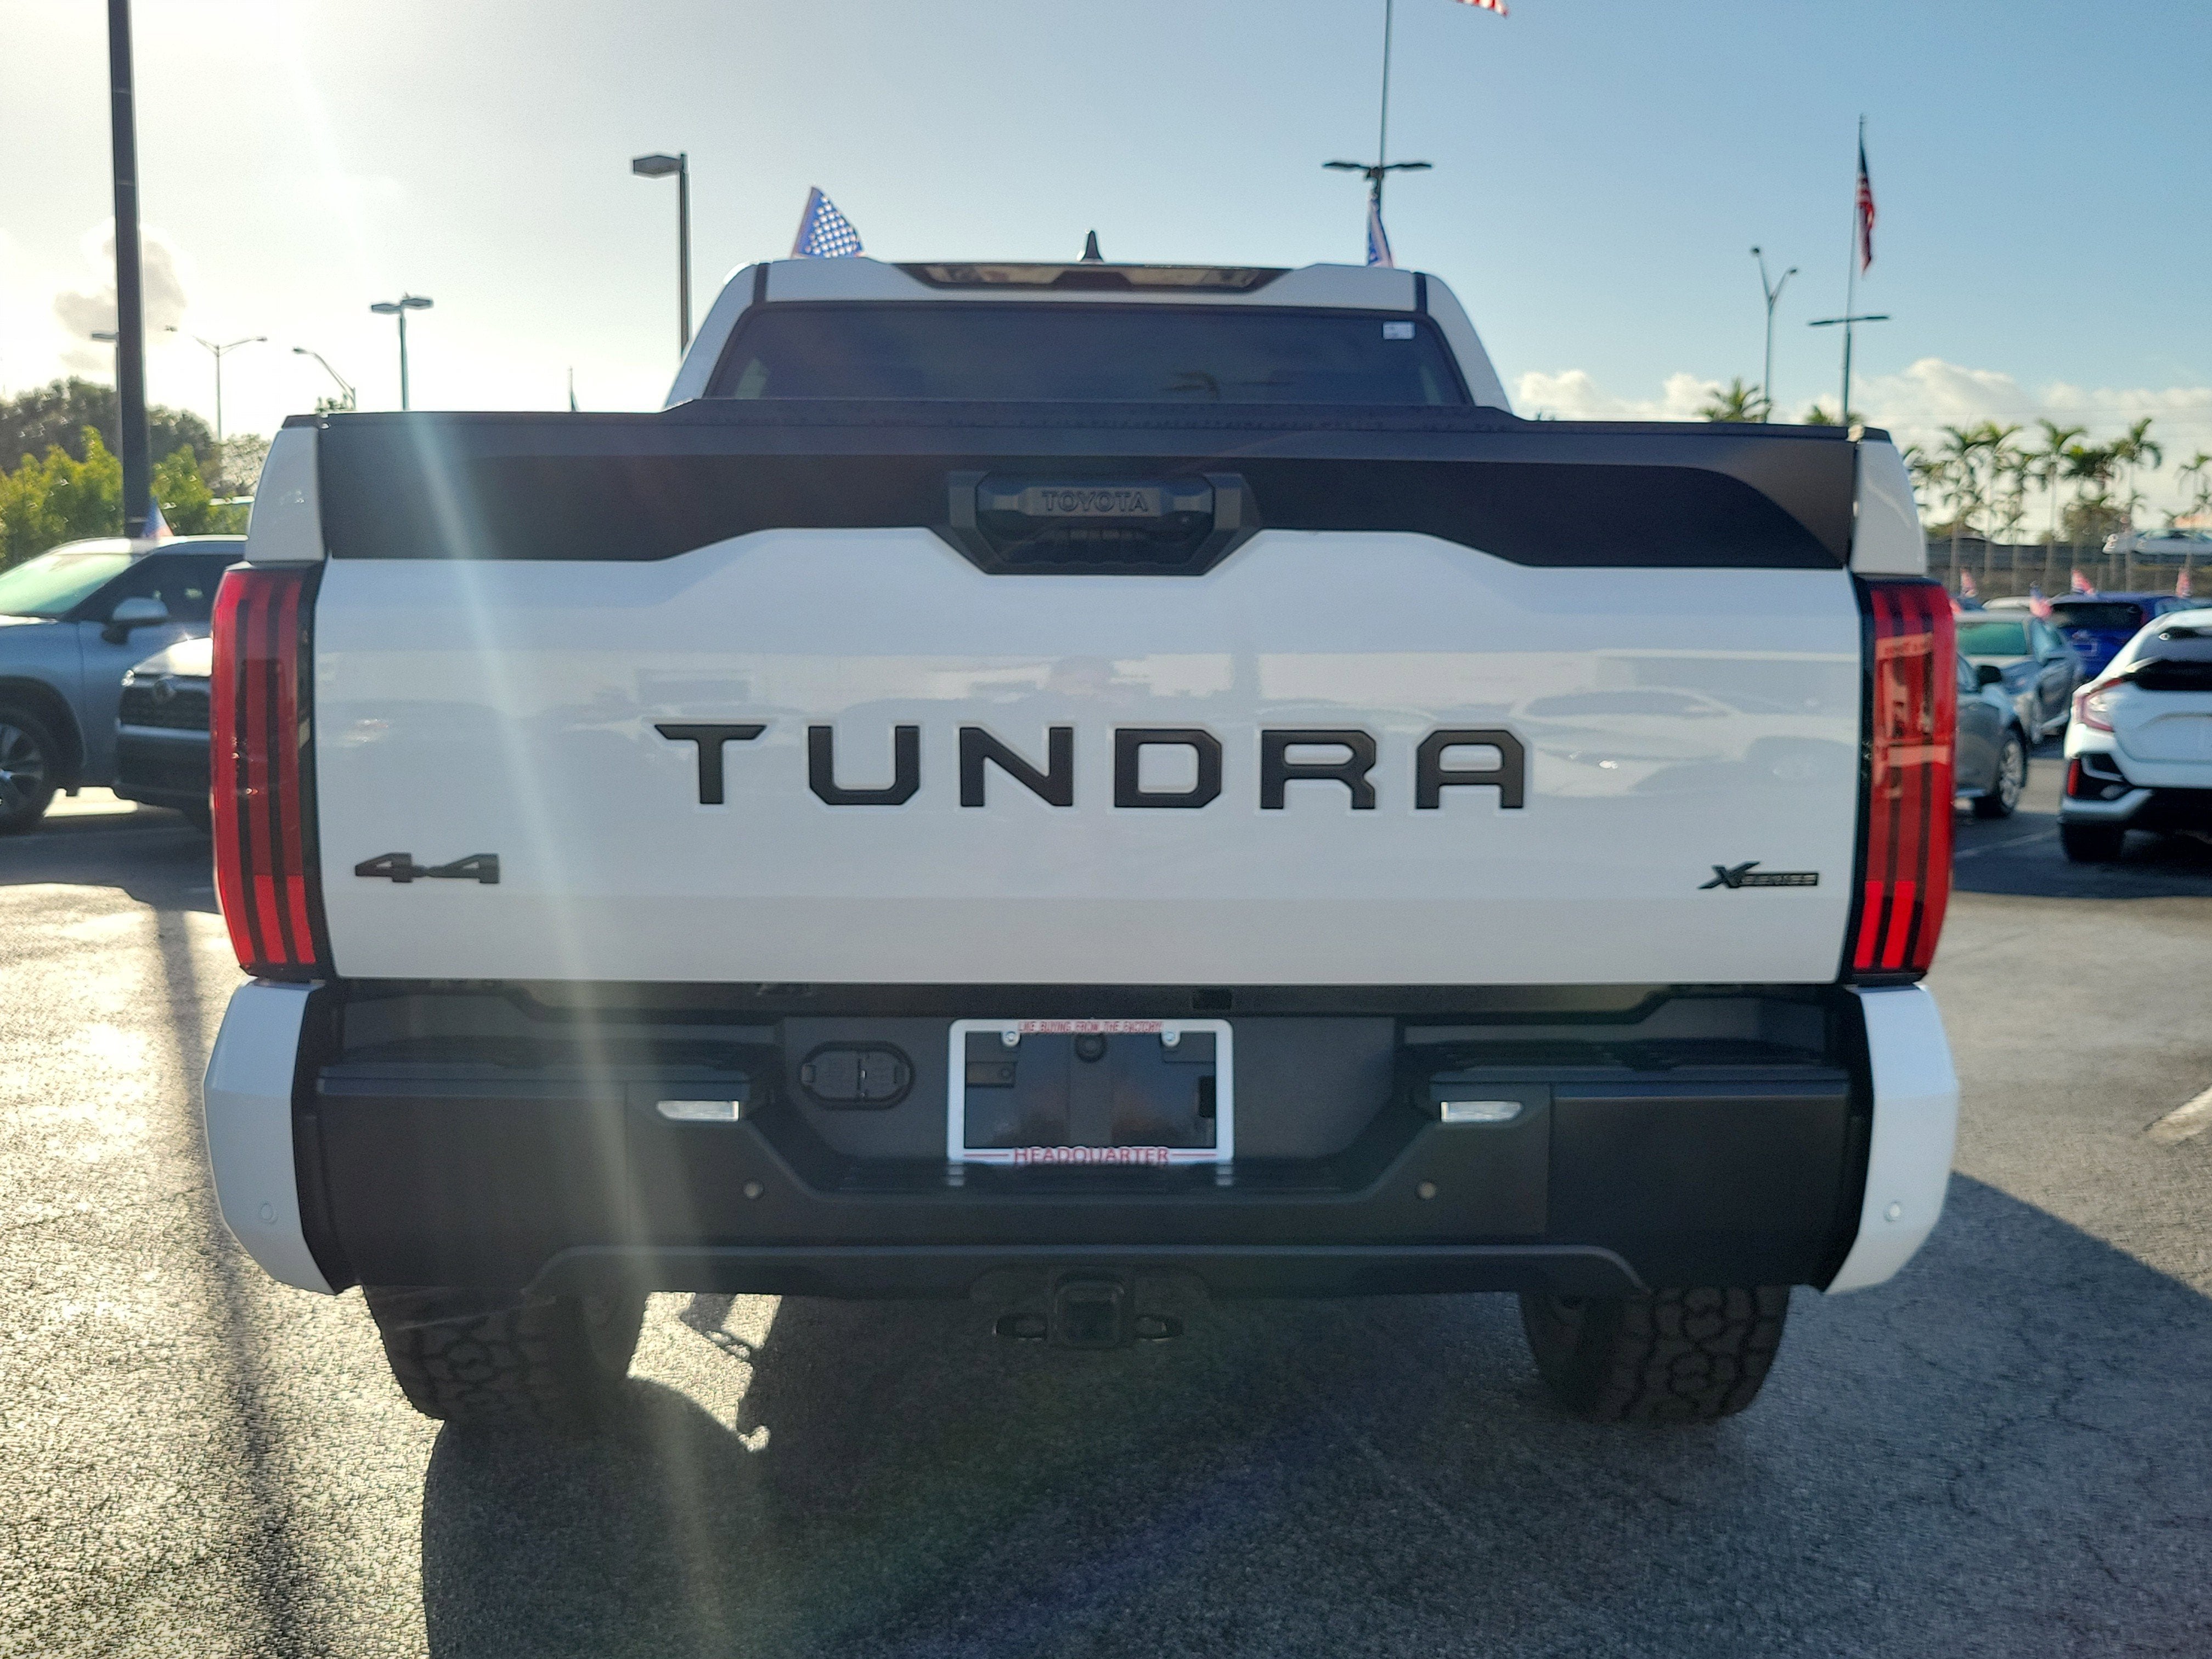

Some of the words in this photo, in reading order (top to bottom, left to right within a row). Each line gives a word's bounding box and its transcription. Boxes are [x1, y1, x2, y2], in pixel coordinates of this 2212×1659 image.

[1041, 490, 1148, 512] TOYOTA
[653, 724, 1526, 810] TUNDRA
[1014, 1147, 1169, 1164] HEADQUARTER
